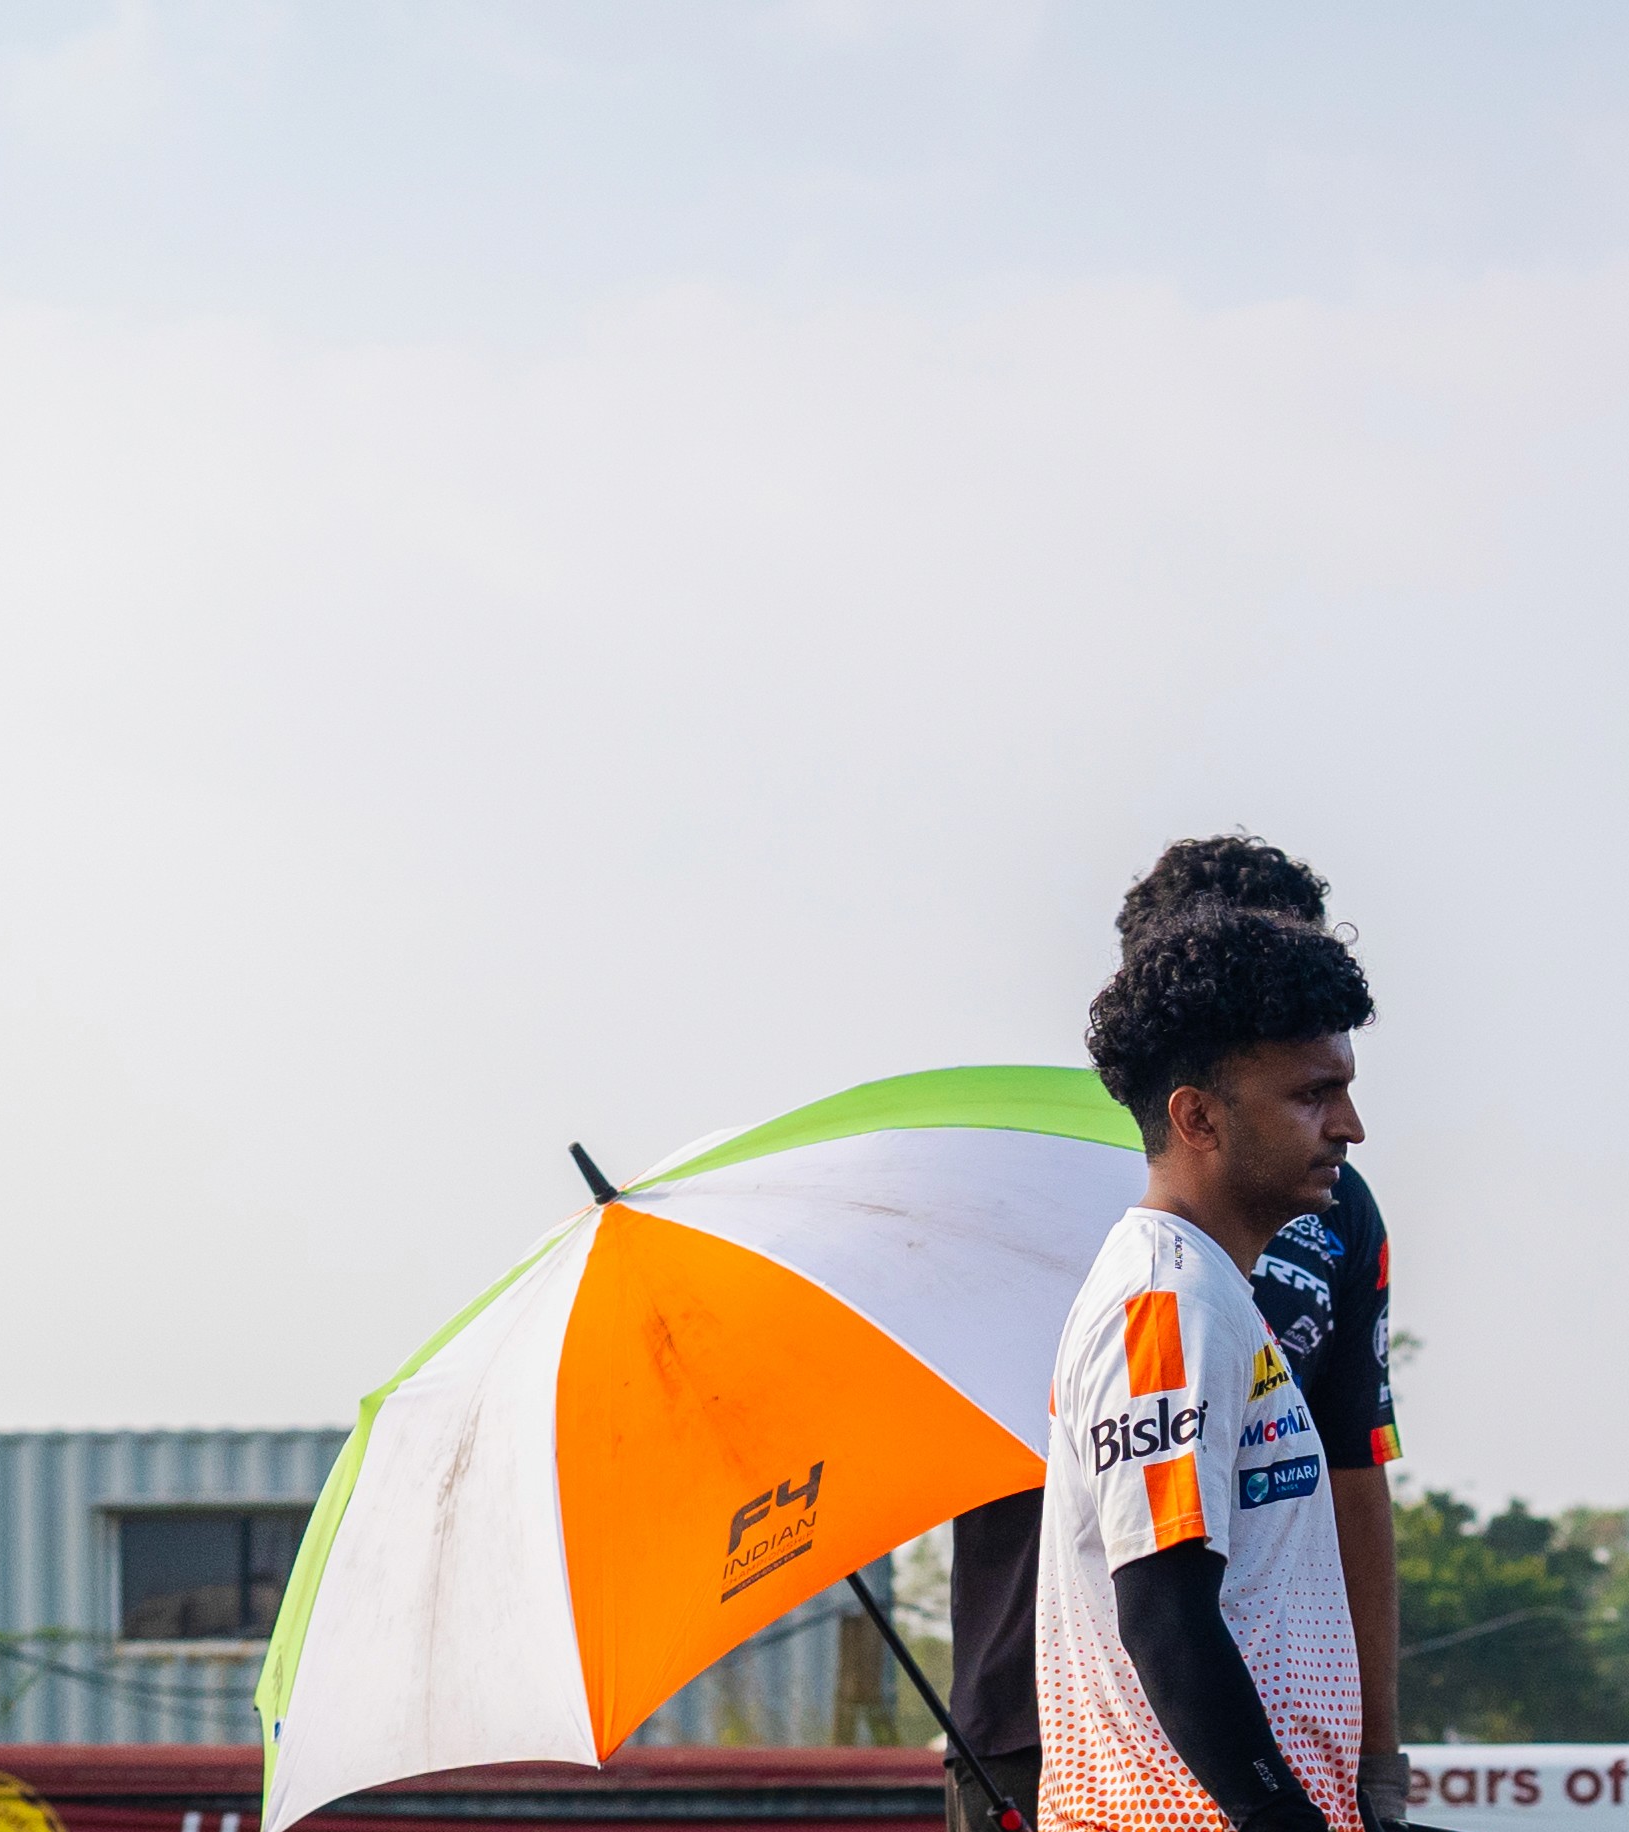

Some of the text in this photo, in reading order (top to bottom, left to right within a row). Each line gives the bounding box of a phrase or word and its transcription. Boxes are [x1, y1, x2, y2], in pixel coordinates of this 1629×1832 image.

[726, 1460, 825, 1556] F4
[722, 1511, 817, 1580] INDIAN
[722, 1528, 815, 1590] CHAMPIONSHIP
[1565, 1759, 1629, 1806] of
